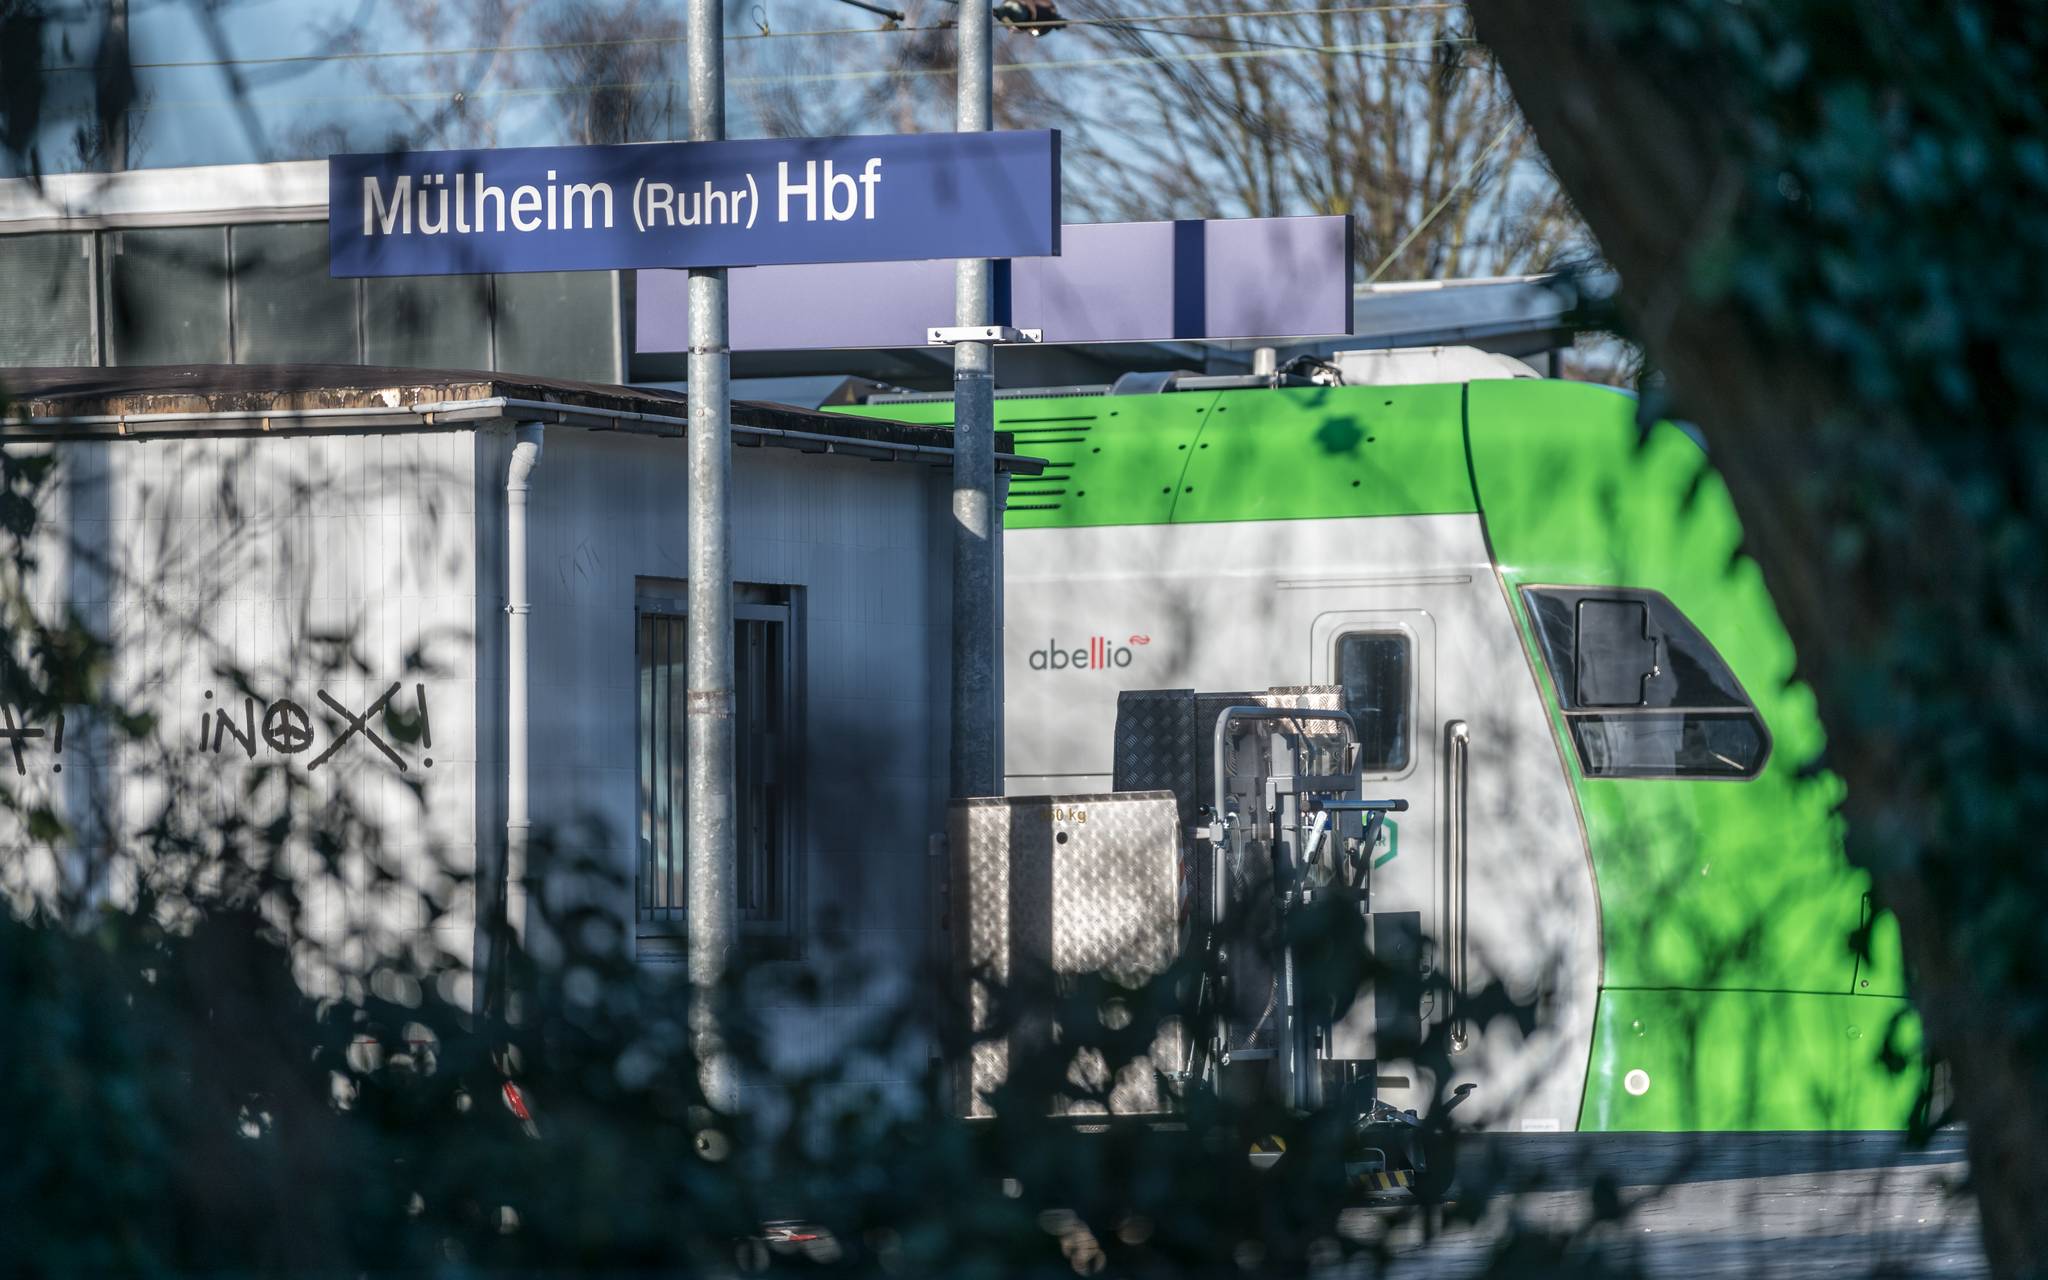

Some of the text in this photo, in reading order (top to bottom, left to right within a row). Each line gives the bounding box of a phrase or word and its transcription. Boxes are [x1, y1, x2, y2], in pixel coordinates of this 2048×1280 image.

[362, 157, 882, 237] Mülheim (Ruhr) Hbf
[1029, 636, 1132, 670] abellio
[1068, 808, 1087, 823] kg
